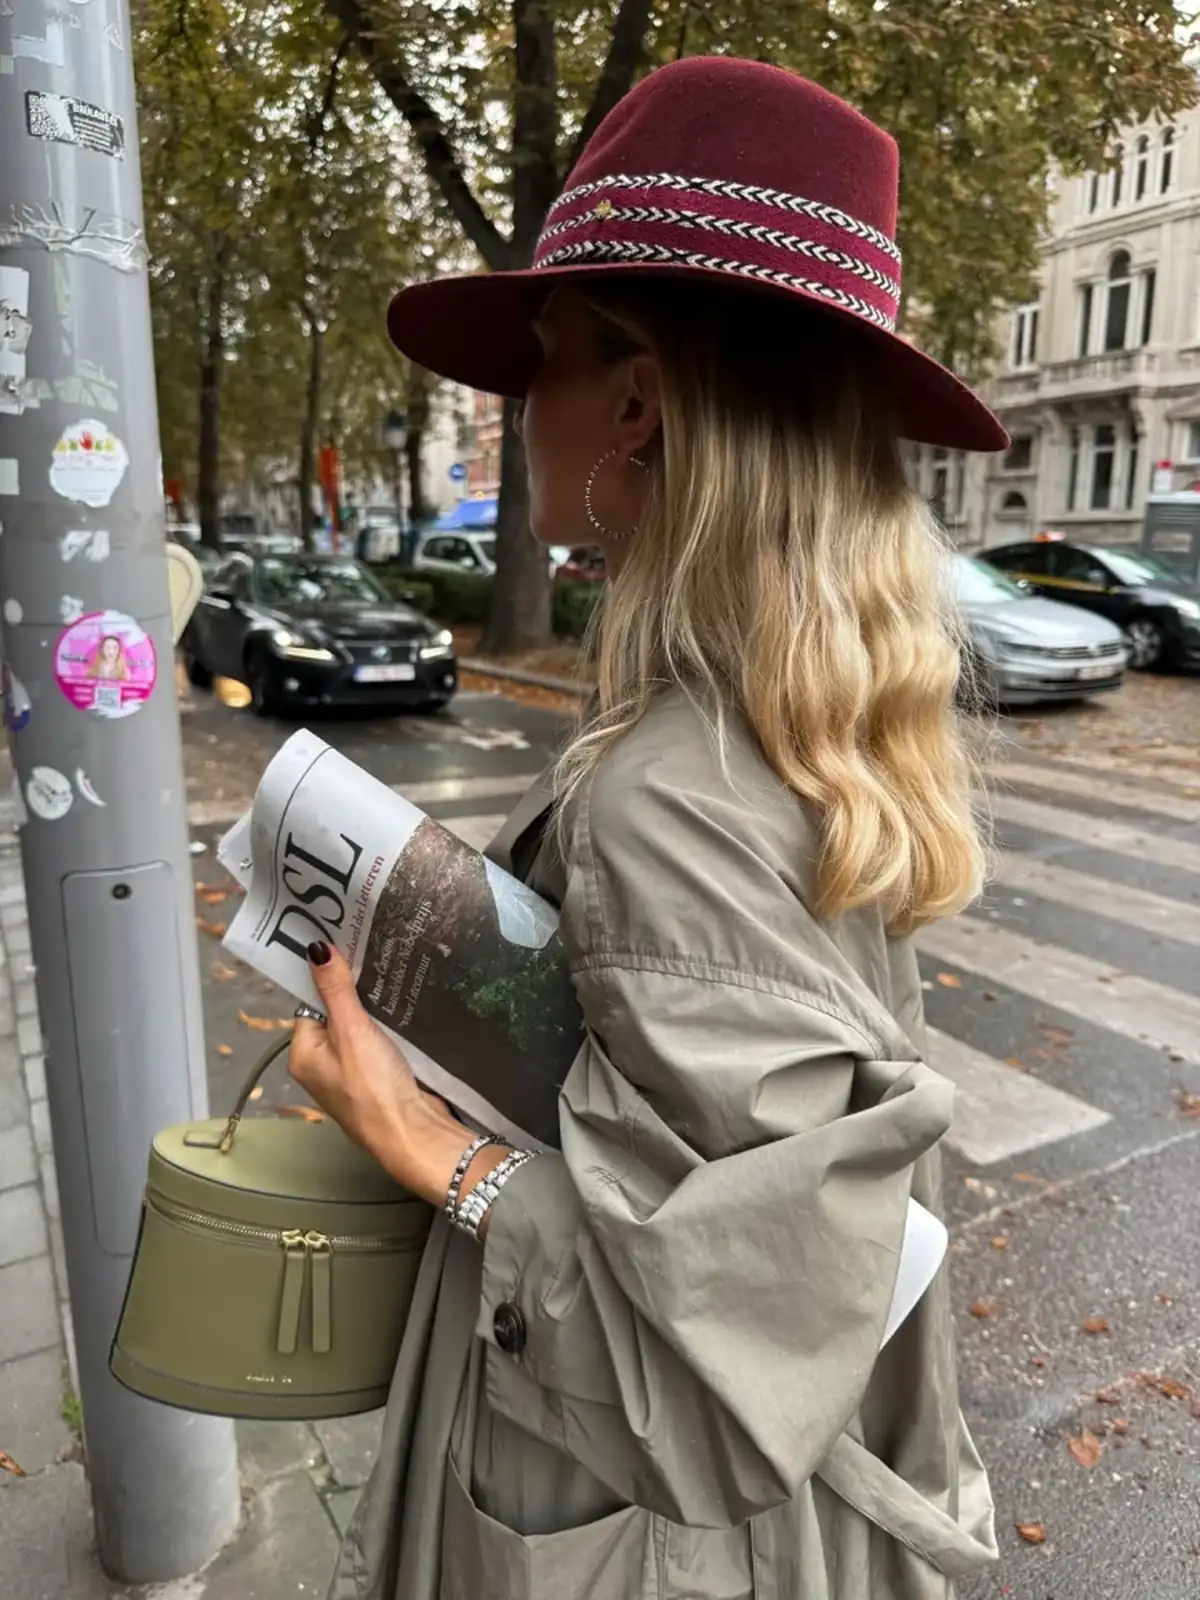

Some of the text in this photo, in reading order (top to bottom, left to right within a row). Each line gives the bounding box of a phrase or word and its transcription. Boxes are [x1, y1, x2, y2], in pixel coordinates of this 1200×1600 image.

[265, 831, 364, 961] DSL
[356, 855, 385, 908] Letteren
[398, 898, 433, 962] Nobelprijs
[367, 976, 385, 1005] Anne
[399, 1003, 416, 1028] voor
